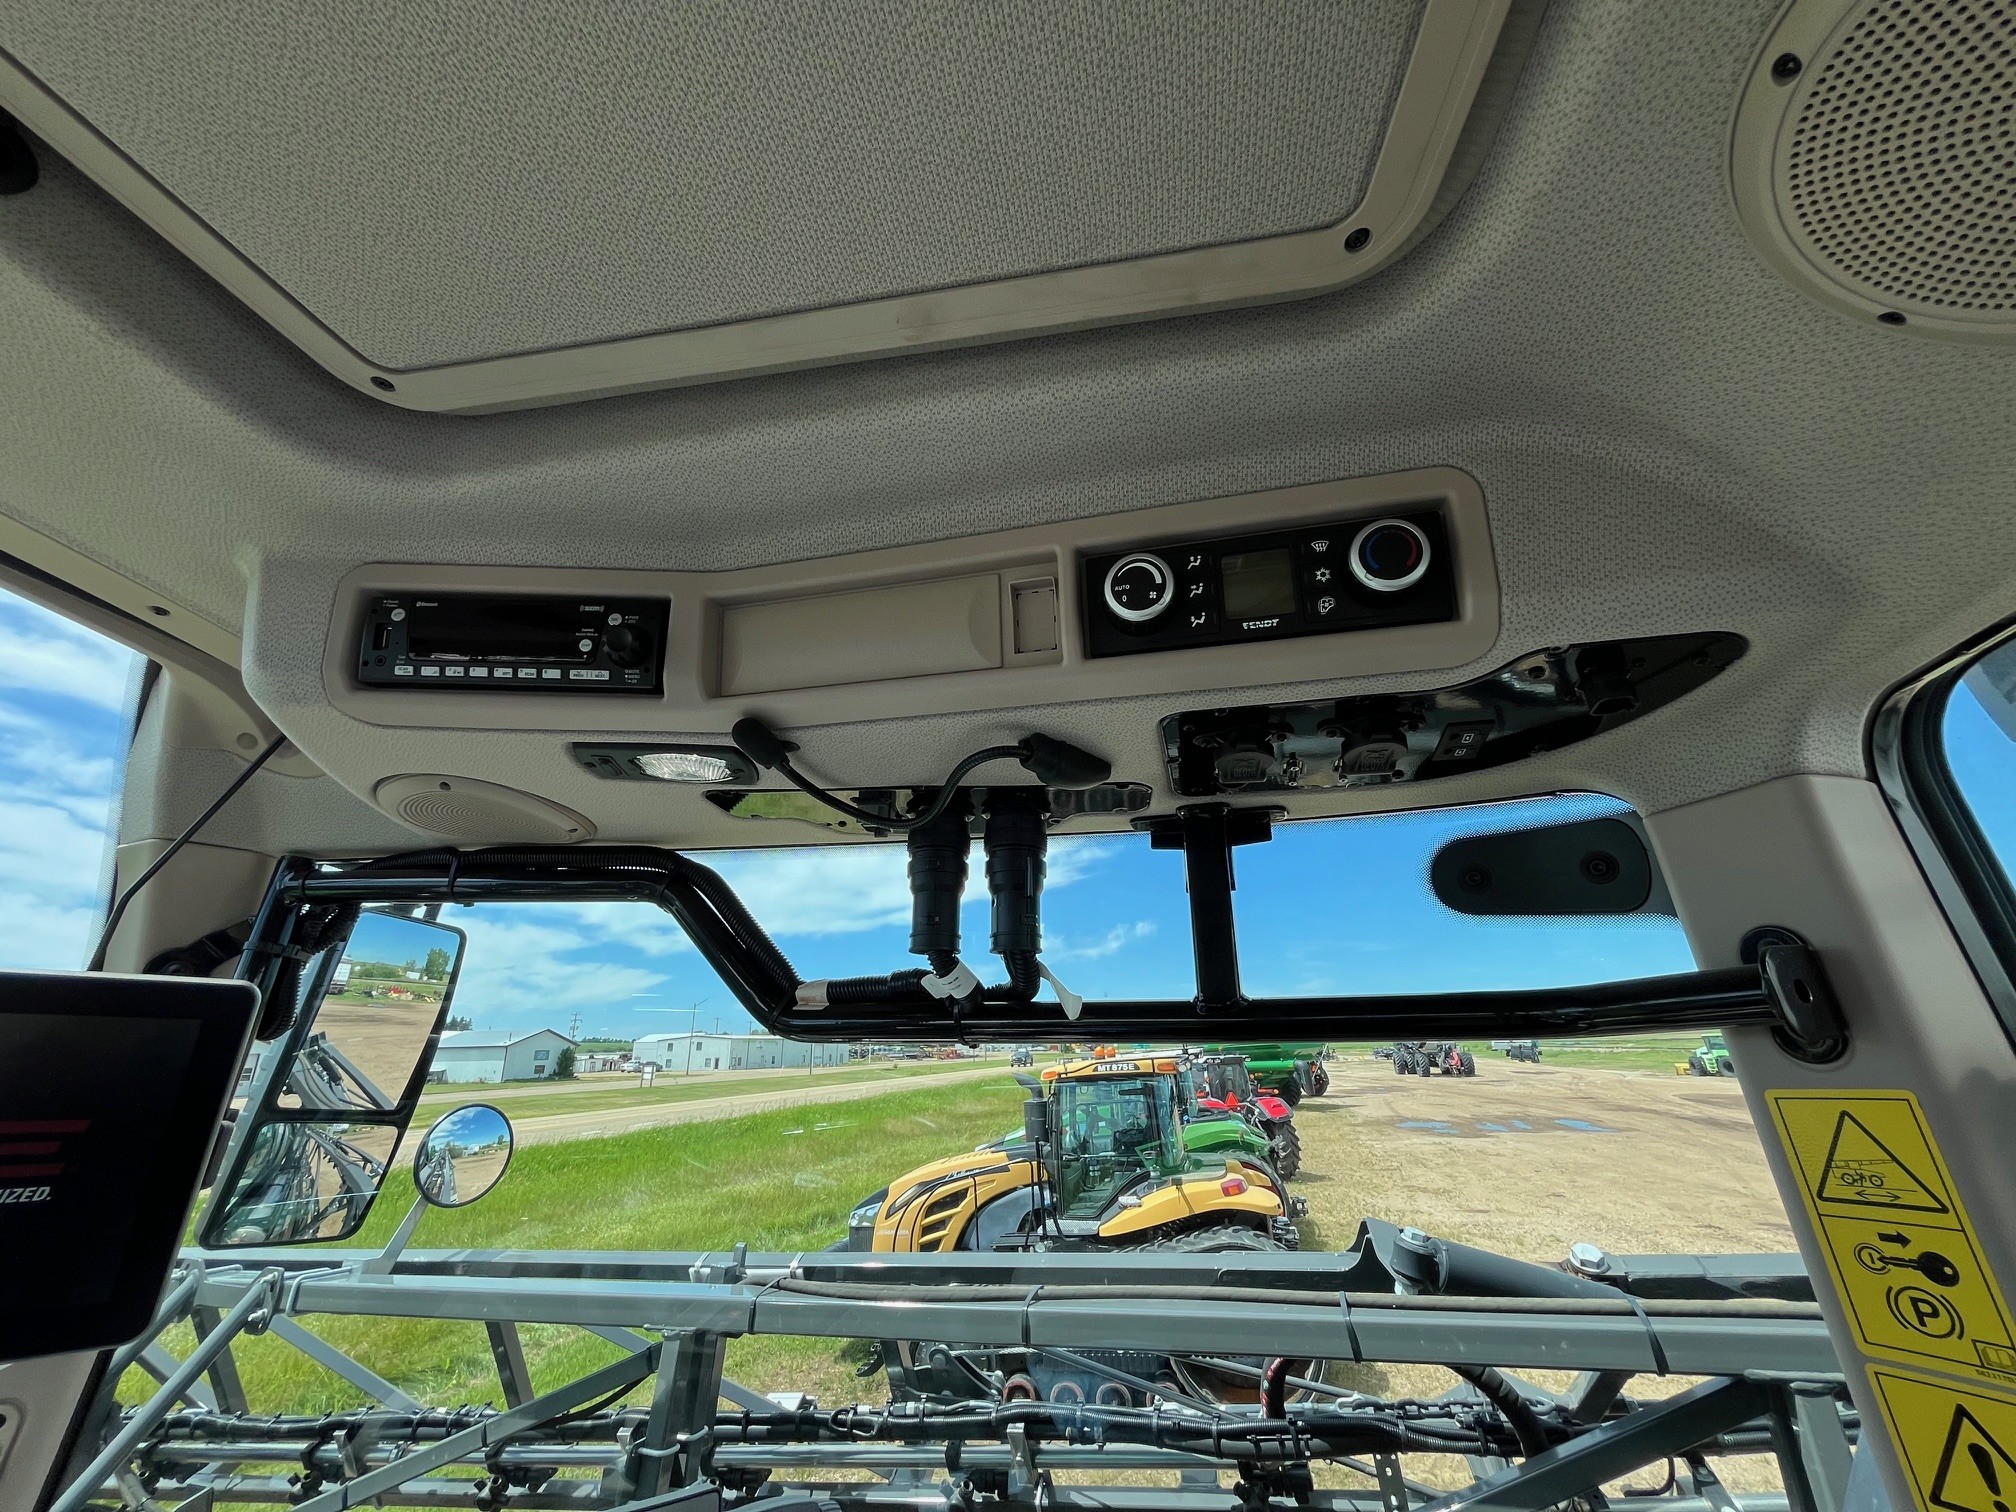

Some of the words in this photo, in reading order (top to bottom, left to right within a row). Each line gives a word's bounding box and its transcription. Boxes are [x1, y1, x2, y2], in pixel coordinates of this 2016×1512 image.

[1242, 618, 1280, 630] FENDT
[0, 1186, 51, 1203] IZED.
[1909, 1295, 1941, 1328] P
